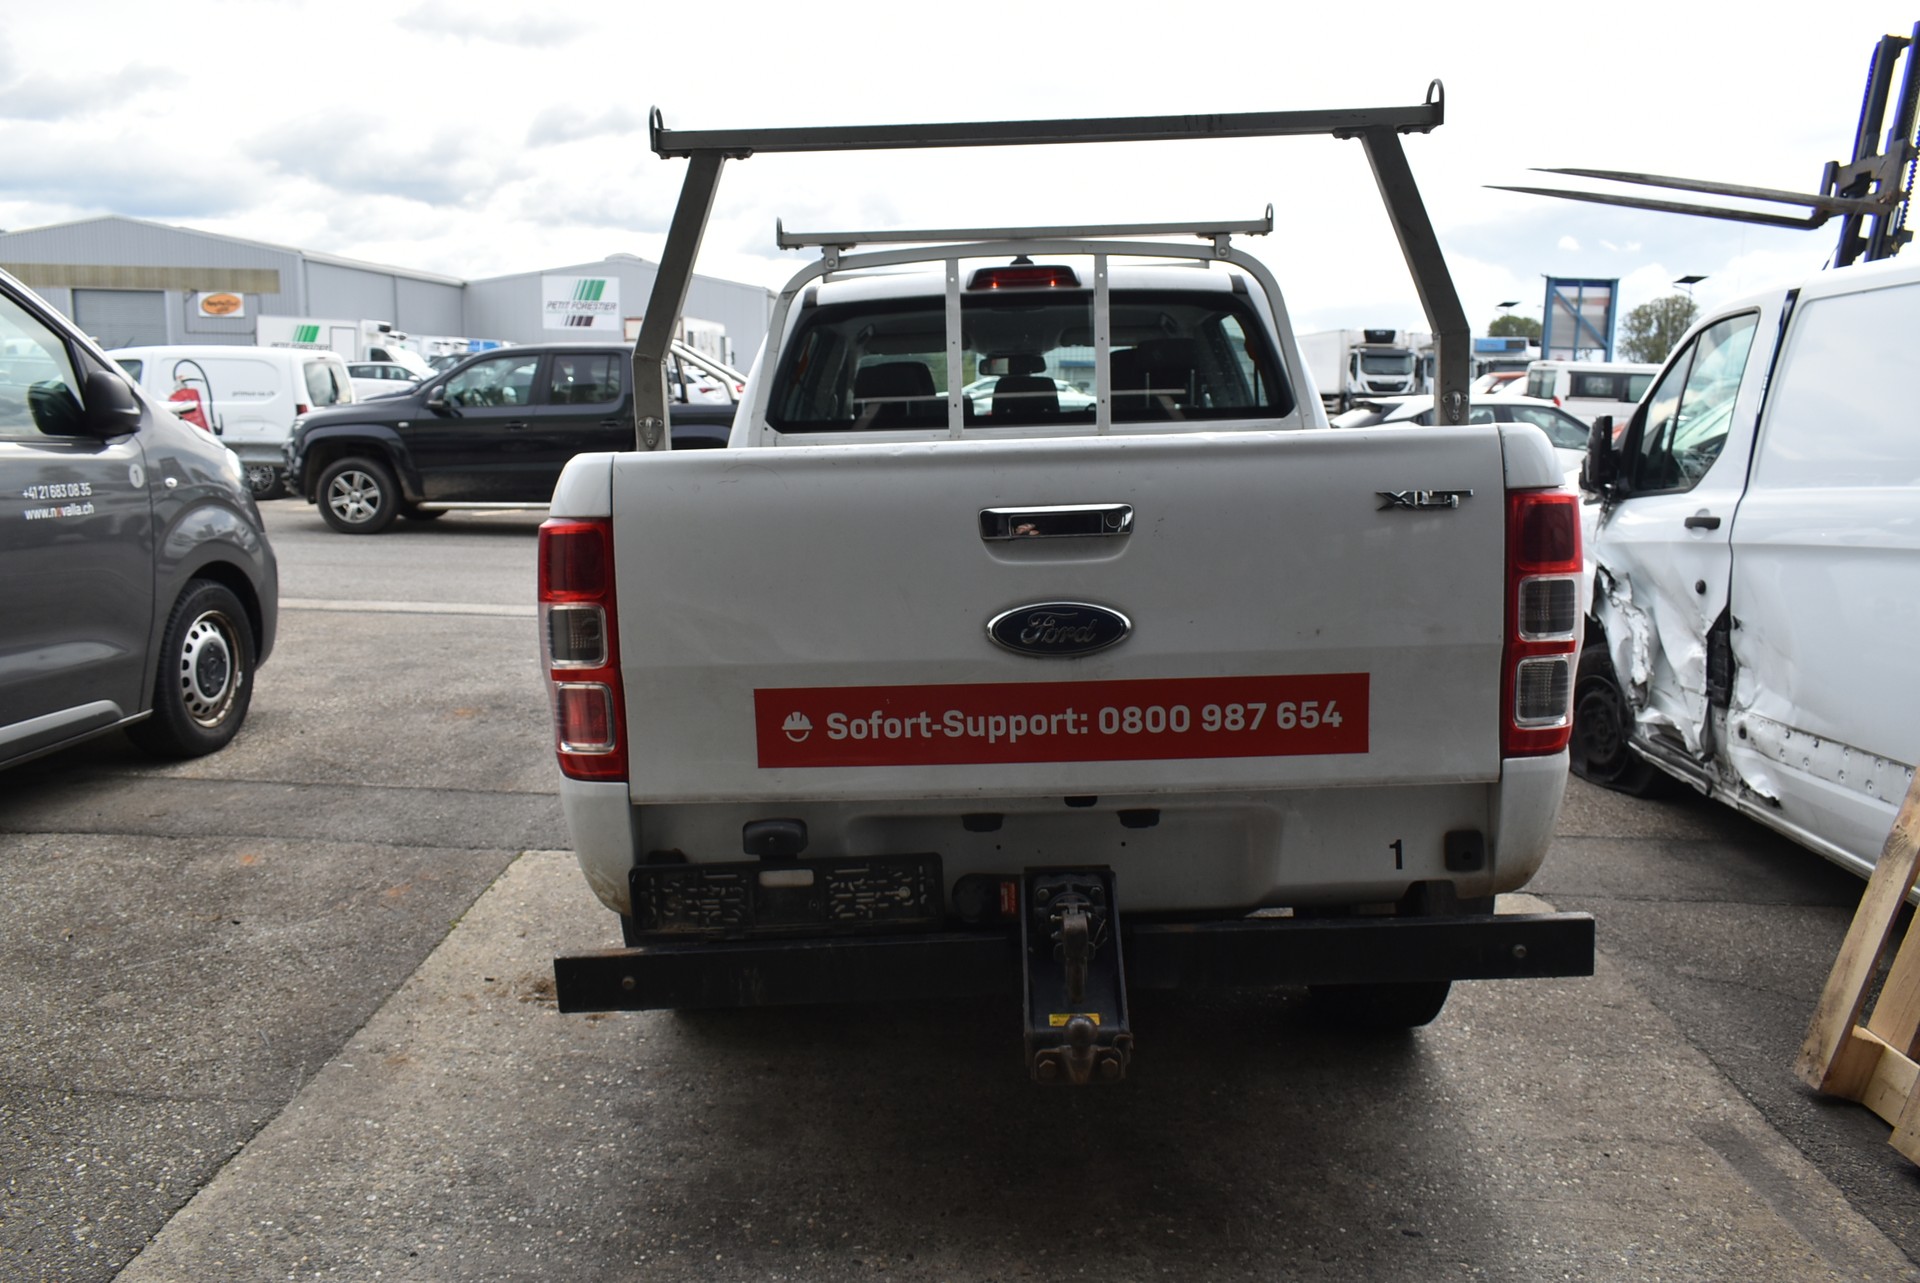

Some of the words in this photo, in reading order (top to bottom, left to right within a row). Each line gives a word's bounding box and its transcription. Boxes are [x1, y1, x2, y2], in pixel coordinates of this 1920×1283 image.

[546, 301, 570, 309] PETIT
[571, 301, 617, 310] FORESTIER
[23, 486, 38, 499] +41
[39, 485, 49, 499] 21
[50, 484, 67, 498] 683
[68, 483, 79, 497] 08
[80, 482, 92, 496] 35
[1376, 489, 1473, 512] XLT
[25, 502, 94, 520] www.novalla.ch
[1020, 611, 1098, 644] Ford
[826, 708, 1088, 744] Sofort-Support:
[1098, 704, 1191, 735] 0800
[1201, 702, 1267, 732] 987
[1276, 700, 1343, 730] 654
[1389, 839, 1403, 870] 1
